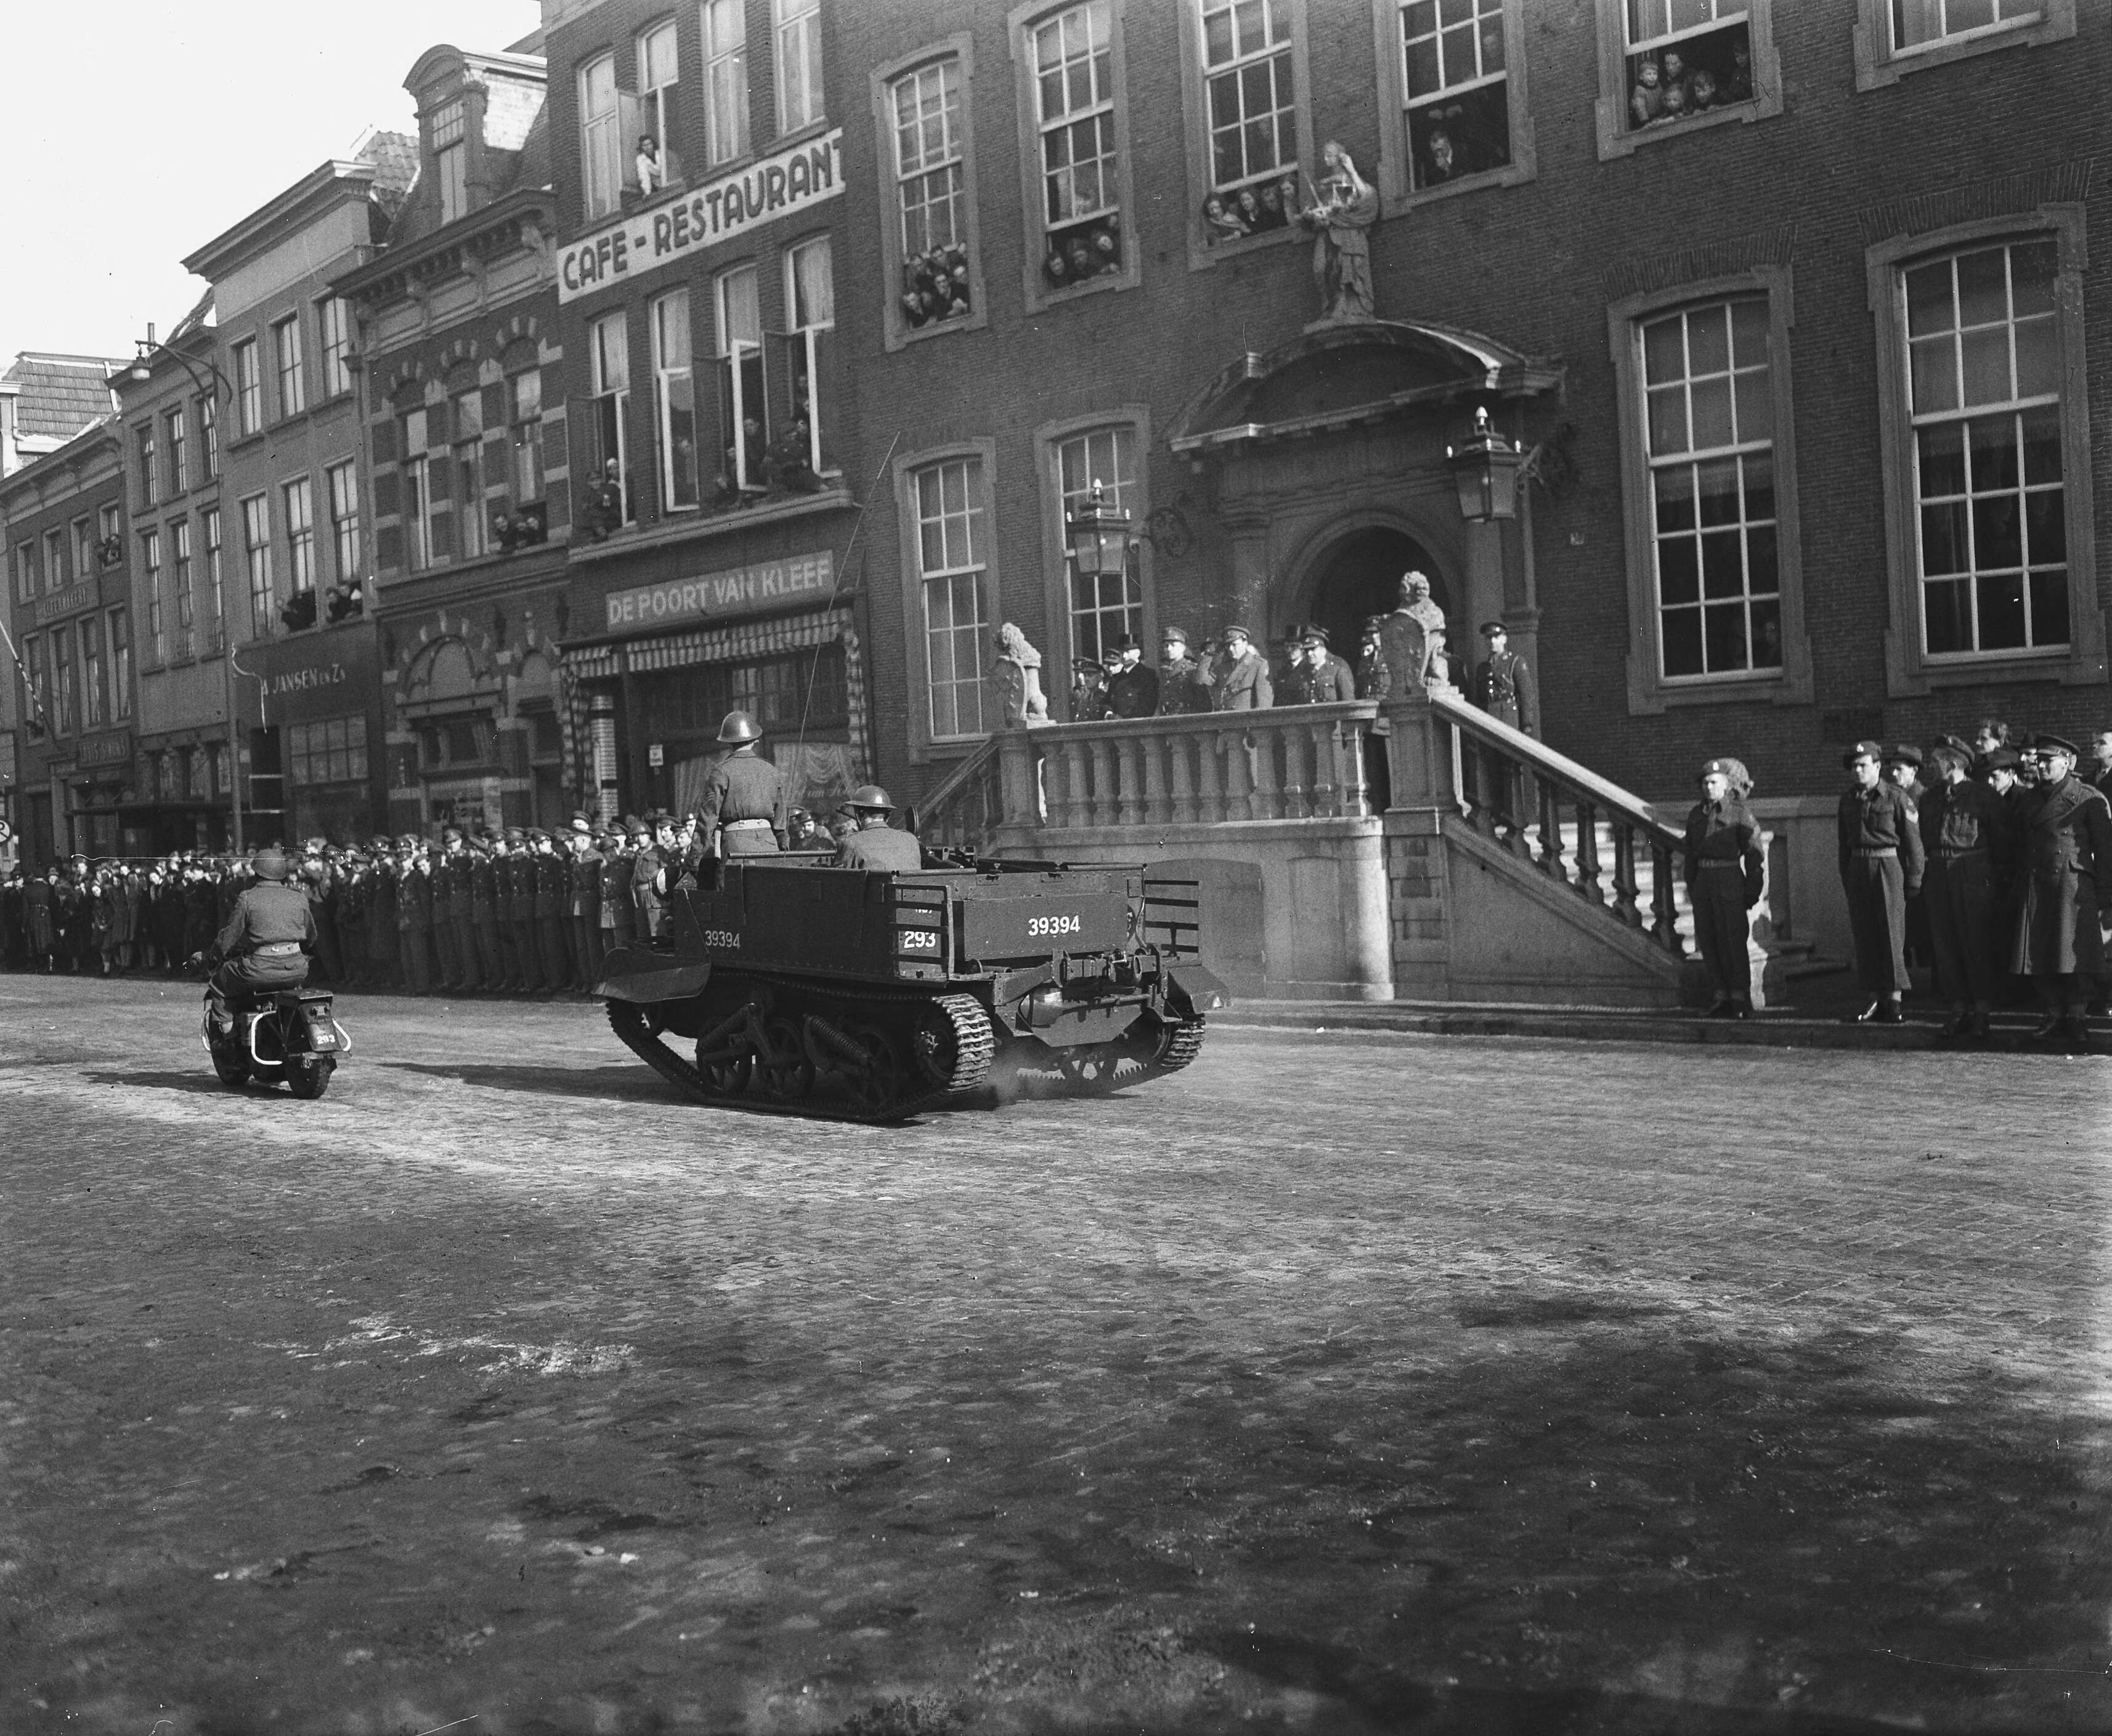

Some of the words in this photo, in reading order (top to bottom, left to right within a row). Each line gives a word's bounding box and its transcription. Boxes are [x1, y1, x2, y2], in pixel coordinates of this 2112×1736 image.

[609, 596, 633, 625] DE
[638, 581, 709, 619] POORT
[713, 573, 755, 604] VAN
[762, 559, 830, 597] KLEEF
[273, 668, 317, 694] JANSEN
[1028, 915, 1081, 937] 39394
[705, 930, 740, 949] 39394
[903, 930, 936, 949] 293
